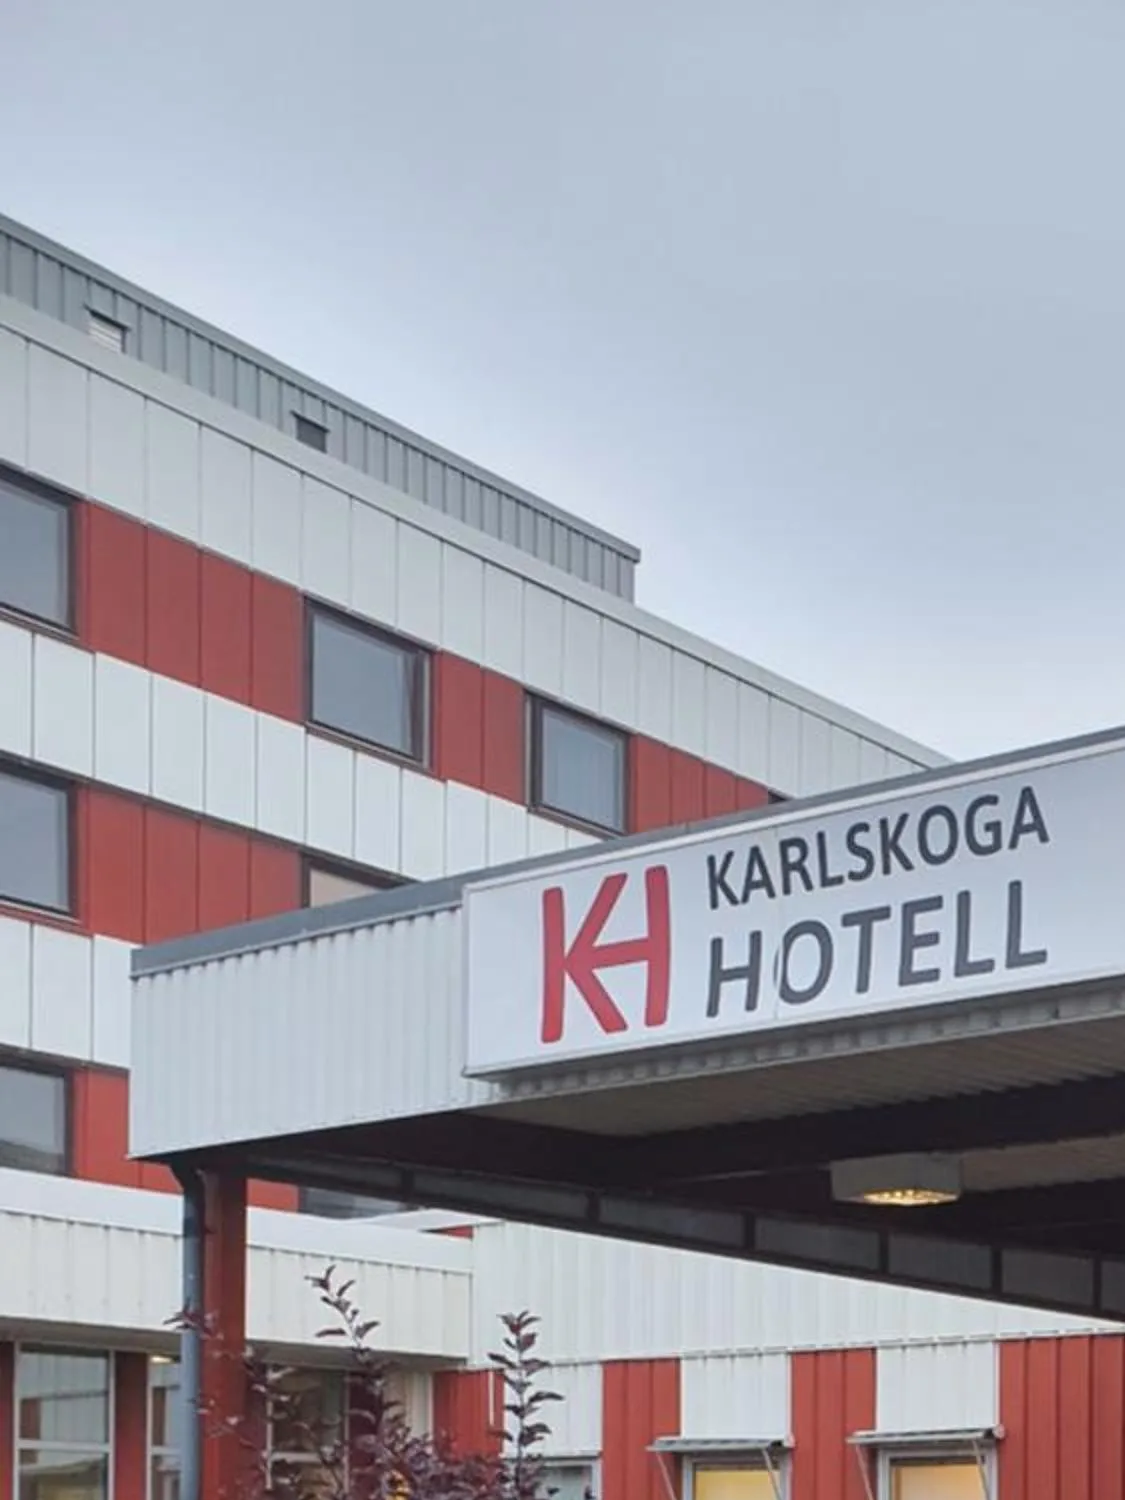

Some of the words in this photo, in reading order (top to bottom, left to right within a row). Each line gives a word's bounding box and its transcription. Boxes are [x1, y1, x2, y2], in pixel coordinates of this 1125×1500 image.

[705, 785, 1050, 911] KARLSKOGA
[541, 865, 671, 1044] KH
[705, 879, 1048, 1018] HOTELL
